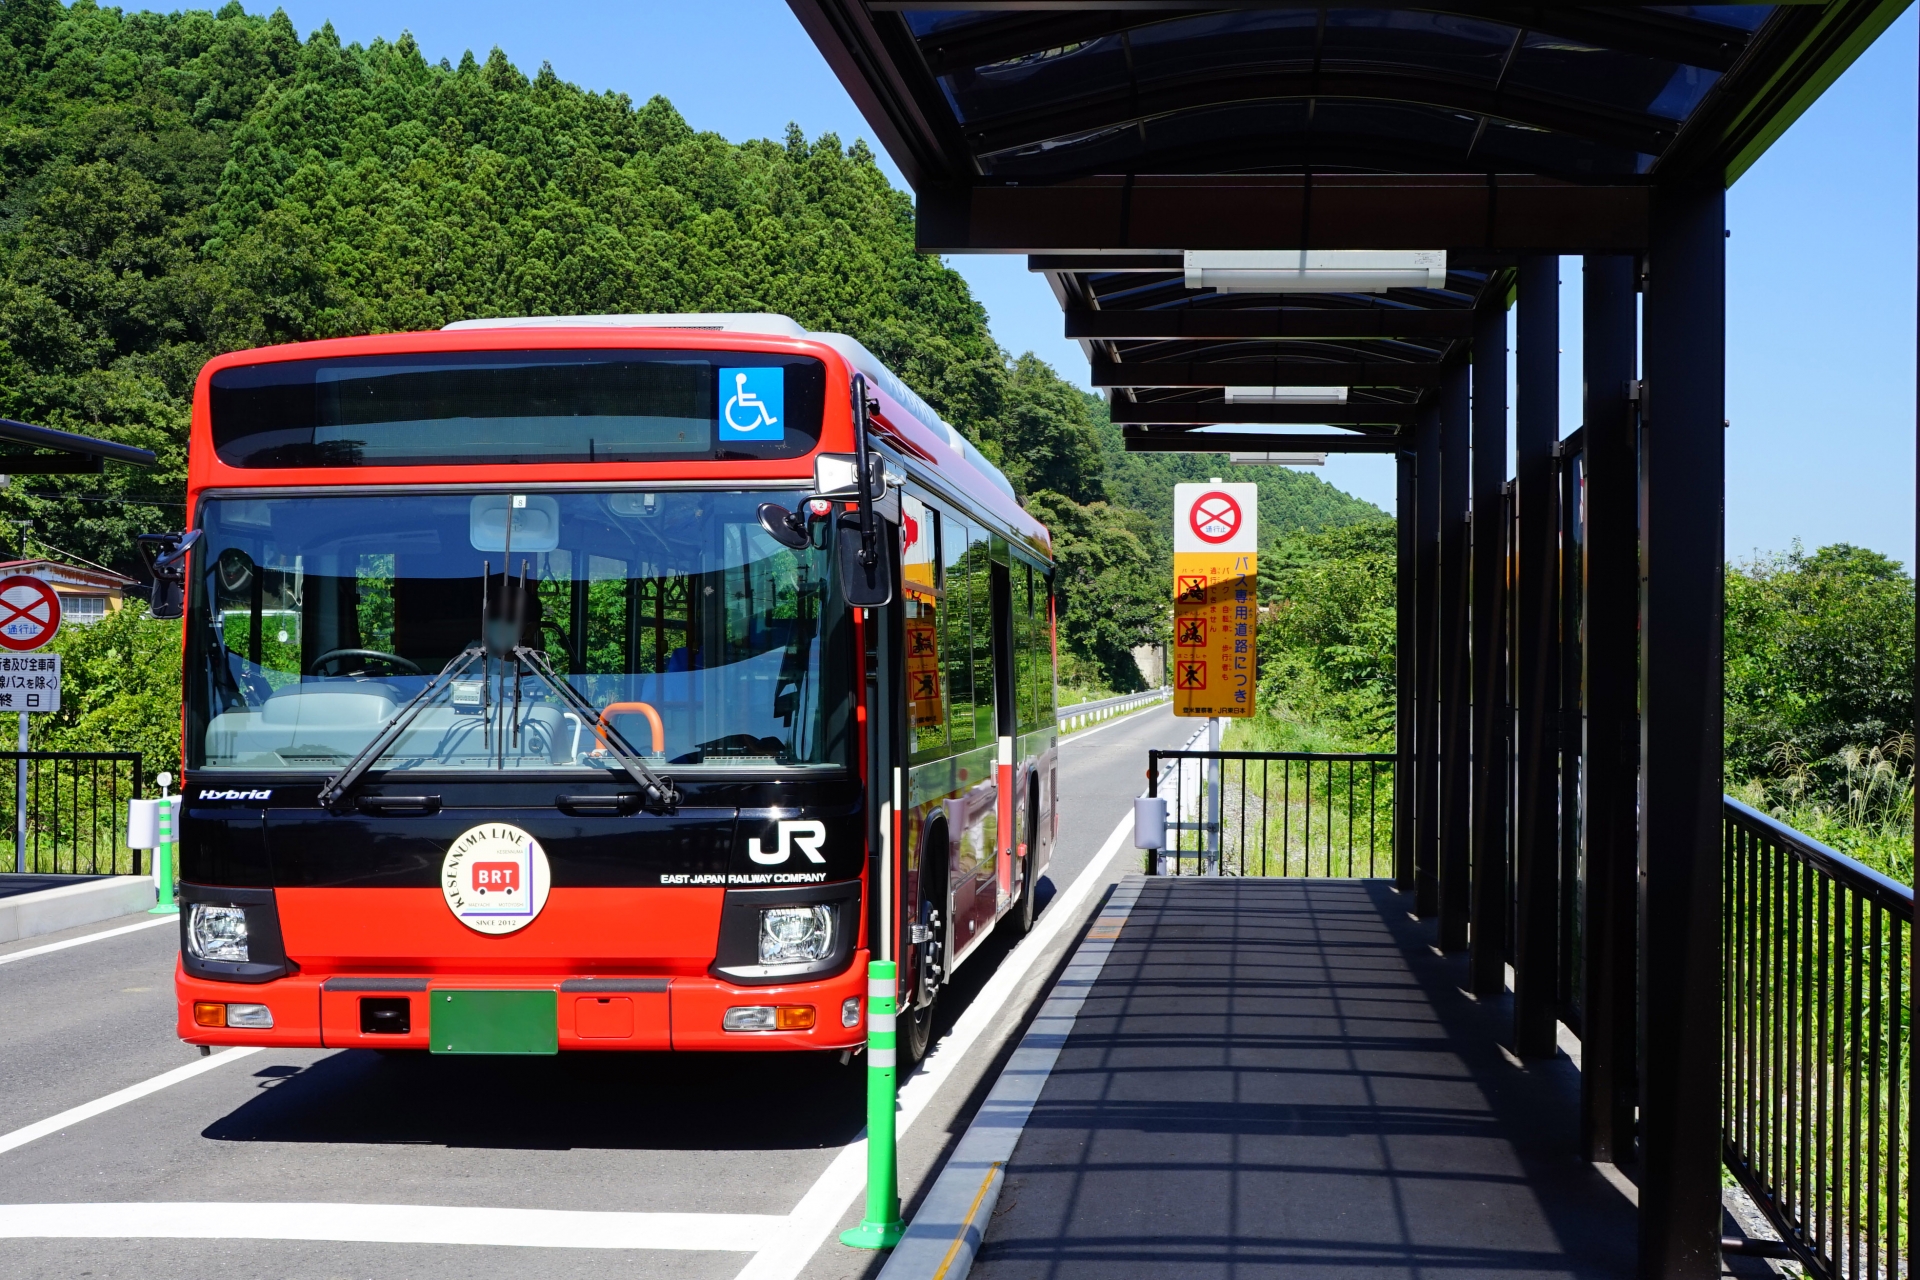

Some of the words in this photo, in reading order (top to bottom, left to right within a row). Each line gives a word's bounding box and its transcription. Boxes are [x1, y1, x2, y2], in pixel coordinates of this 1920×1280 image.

[1205, 525, 1227, 533] 通行止
[1209, 566, 1218, 633] 通行できません
[7, 624, 39, 635] 通行止
[1234, 556, 1249, 704] バス専用道路につき
[198, 789, 272, 800] Hybrid
[748, 820, 827, 865] JR
[446, 830, 487, 909] KESENNUMA
[492, 828, 525, 847] LINE
[478, 869, 513, 884] BRT
[660, 874, 690, 883] EAST
[690, 874, 726, 883] JAPAN
[728, 873, 773, 883] RAILWAY
[773, 872, 827, 883] COMPANY
